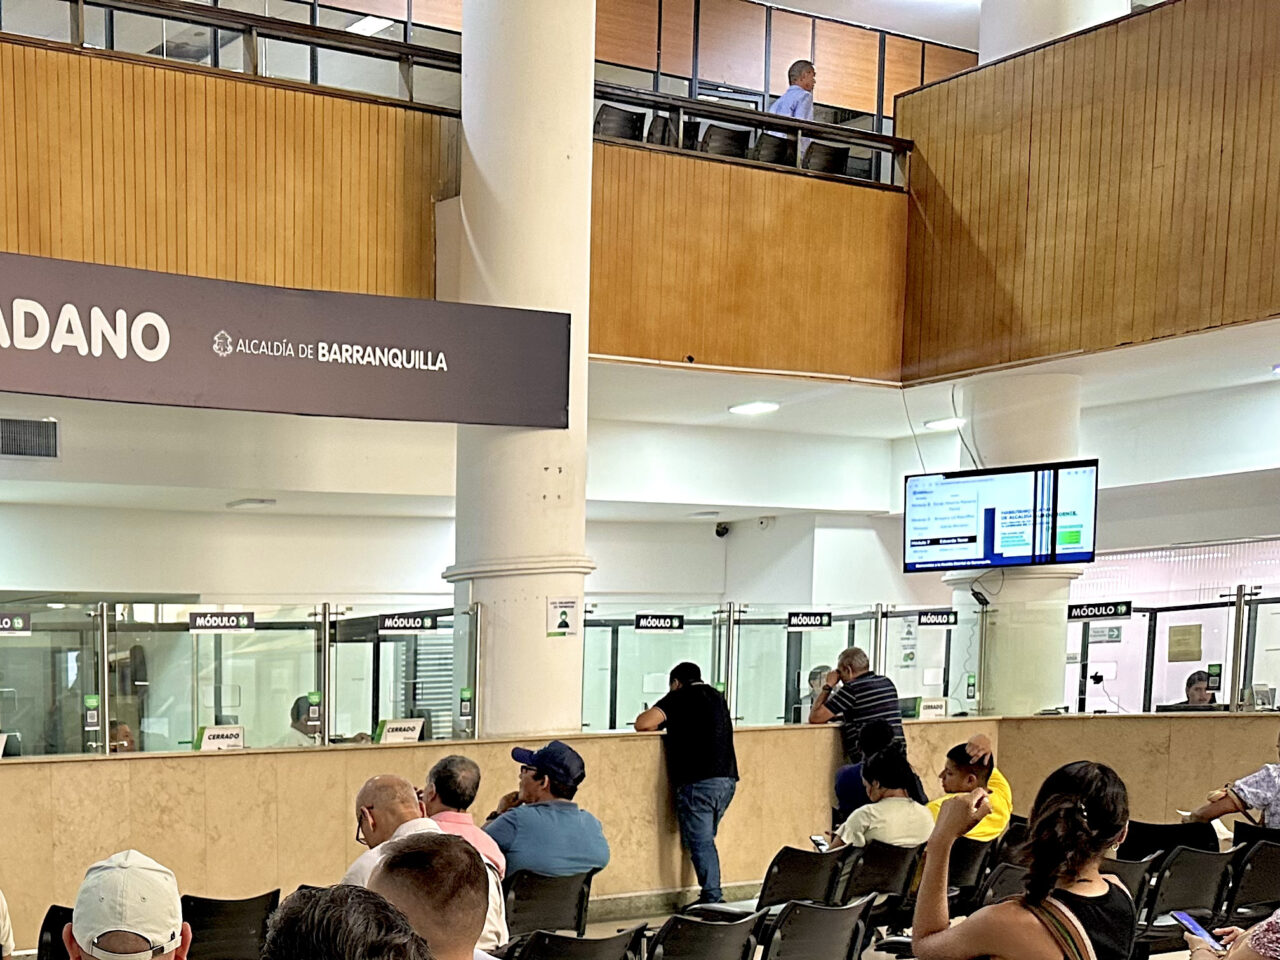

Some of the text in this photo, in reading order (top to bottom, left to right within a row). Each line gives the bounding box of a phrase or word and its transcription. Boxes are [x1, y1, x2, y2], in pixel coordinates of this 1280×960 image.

[235, 339, 448, 372] ALCALDÍA DE BARRANQUILLA
[1071, 605, 1114, 617] MÓDULO
[196, 616, 237, 628] MÓDULO
[384, 616, 422, 629] MÓDULO
[640, 616, 671, 628] MÓDULO
[791, 613, 821, 625] MÓDULO
[920, 613, 948, 624] MÓDULO
[387, 725, 416, 733] CERRADO
[207, 732, 239, 740] CERRADO
